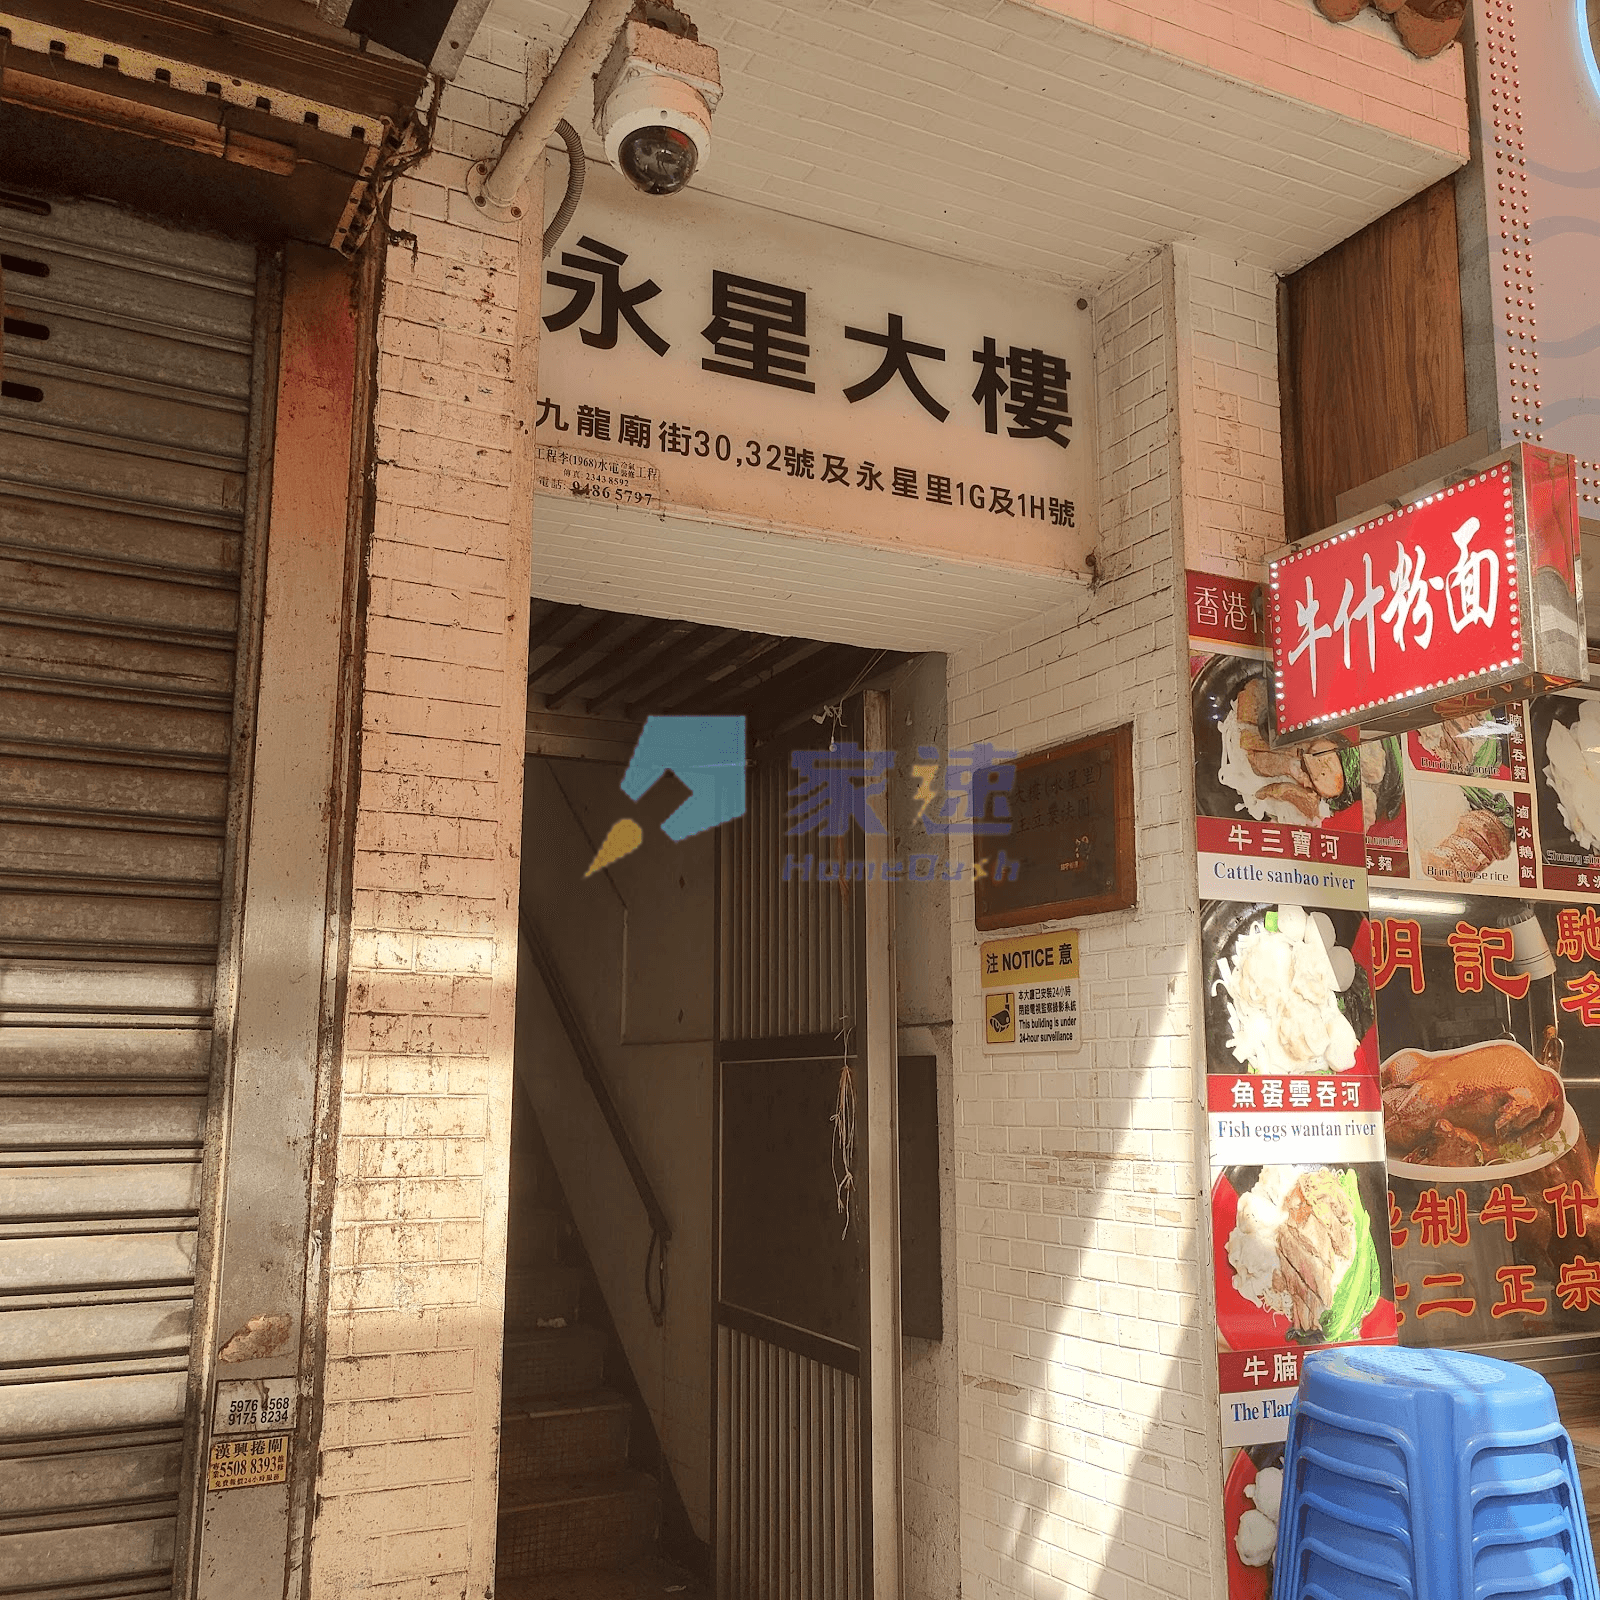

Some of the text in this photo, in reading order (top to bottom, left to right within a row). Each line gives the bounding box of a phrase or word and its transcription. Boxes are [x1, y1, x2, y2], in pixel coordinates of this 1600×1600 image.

[541, 235, 1074, 449] 永星大樓
[585, 472, 607, 483] 2343
[608, 476, 629, 487] 8592
[614, 488, 652, 506] 5797
[1287, 516, 1500, 698] 牛什粉面
[1228, 824, 1340, 860] 牛三寶河
[1214, 861, 1356, 890] Cattle sanbao river
[1490, 871, 1509, 882] rice
[986, 943, 1073, 975] 注 NOTICE 意
[1019, 1019, 1031, 1030] This
[1031, 1017, 1053, 1030] building
[1060, 1015, 1077, 1027] under
[1040, 1030, 1073, 1043] surveillance
[1230, 1078, 1361, 1109] 魚蛋雲吞河
[1217, 1119, 1377, 1143] Fish eggs wantan river
[1242, 1350, 1316, 1387] 牛腩
[228, 1409, 289, 1426] 9175 8234
[229, 1400, 259, 1413] 5976
[1230, 1402, 1260, 1422] The
[219, 1455, 277, 1478] 5508 8393
